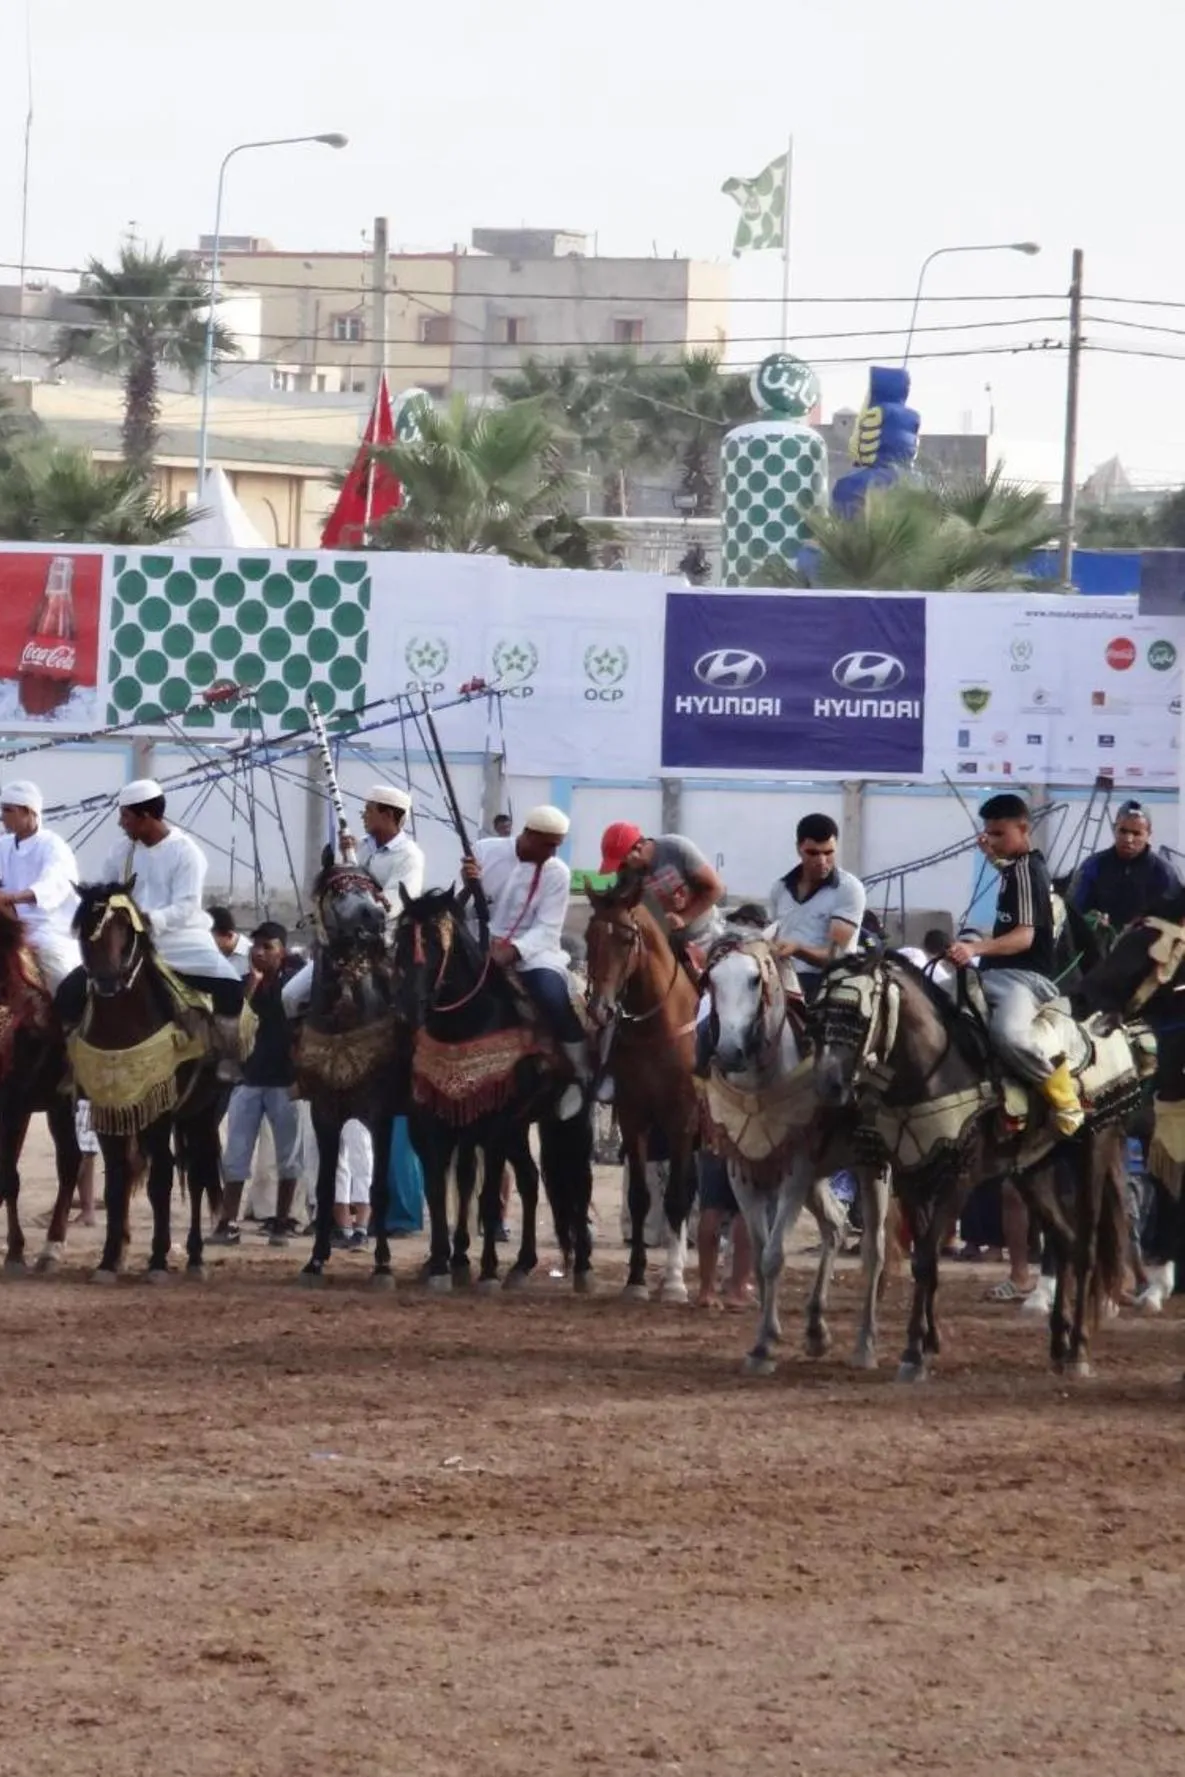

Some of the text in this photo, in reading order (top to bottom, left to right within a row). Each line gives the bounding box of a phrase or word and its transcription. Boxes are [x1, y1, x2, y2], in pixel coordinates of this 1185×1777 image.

[584, 688, 624, 702] OCP
[675, 695, 781, 716] HYUNDAI
[814, 699, 920, 719] HYUNDAI
